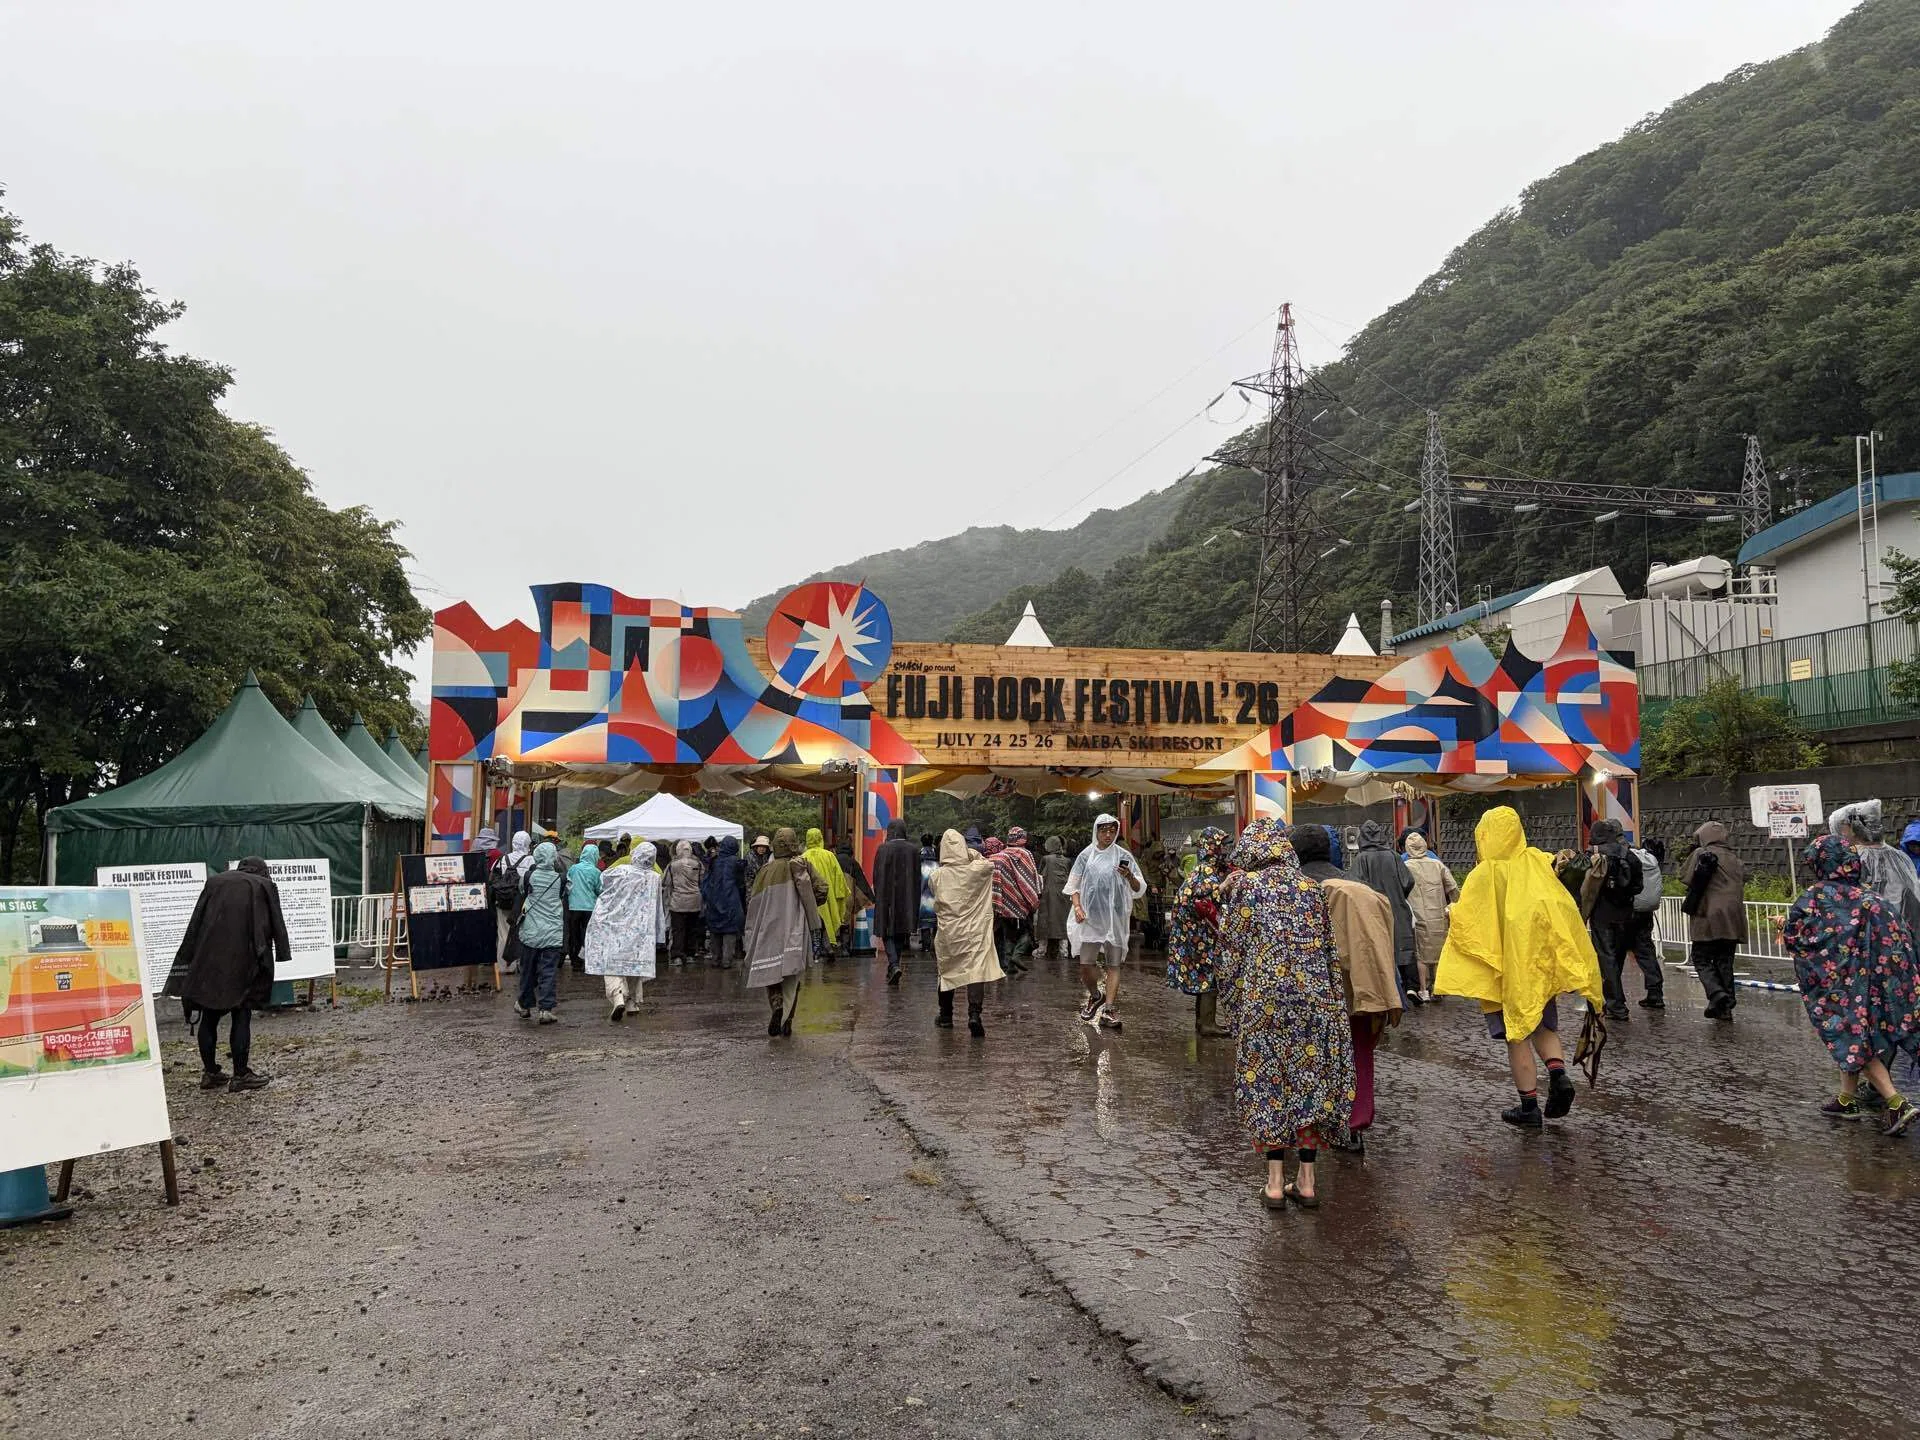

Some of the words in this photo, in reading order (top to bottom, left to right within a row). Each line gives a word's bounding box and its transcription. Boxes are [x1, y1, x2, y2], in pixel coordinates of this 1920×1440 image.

[923, 665, 933, 673] go
[934, 664, 956, 672] round
[887, 674, 963, 720] FUJI
[974, 676, 1066, 722] ROCK
[1075, 678, 1220, 724] FESTIVAL
[936, 732, 976, 749] JULY
[983, 733, 1002, 747] 24
[1009, 734, 1028, 748] 25
[1034, 734, 1054, 748] 26
[1066, 735, 1123, 749] NAEBA
[1128, 736, 1154, 750] SKI
[1162, 736, 1225, 751] RESORT
[268, 865, 283, 875] OCK
[284, 864, 317, 875] FESTIVAL
[112, 872, 131, 883] FUJI
[133, 871, 156, 882] ROCK
[157, 869, 193, 880] FESTIVAL
[9, 901, 38, 911] STAGE
